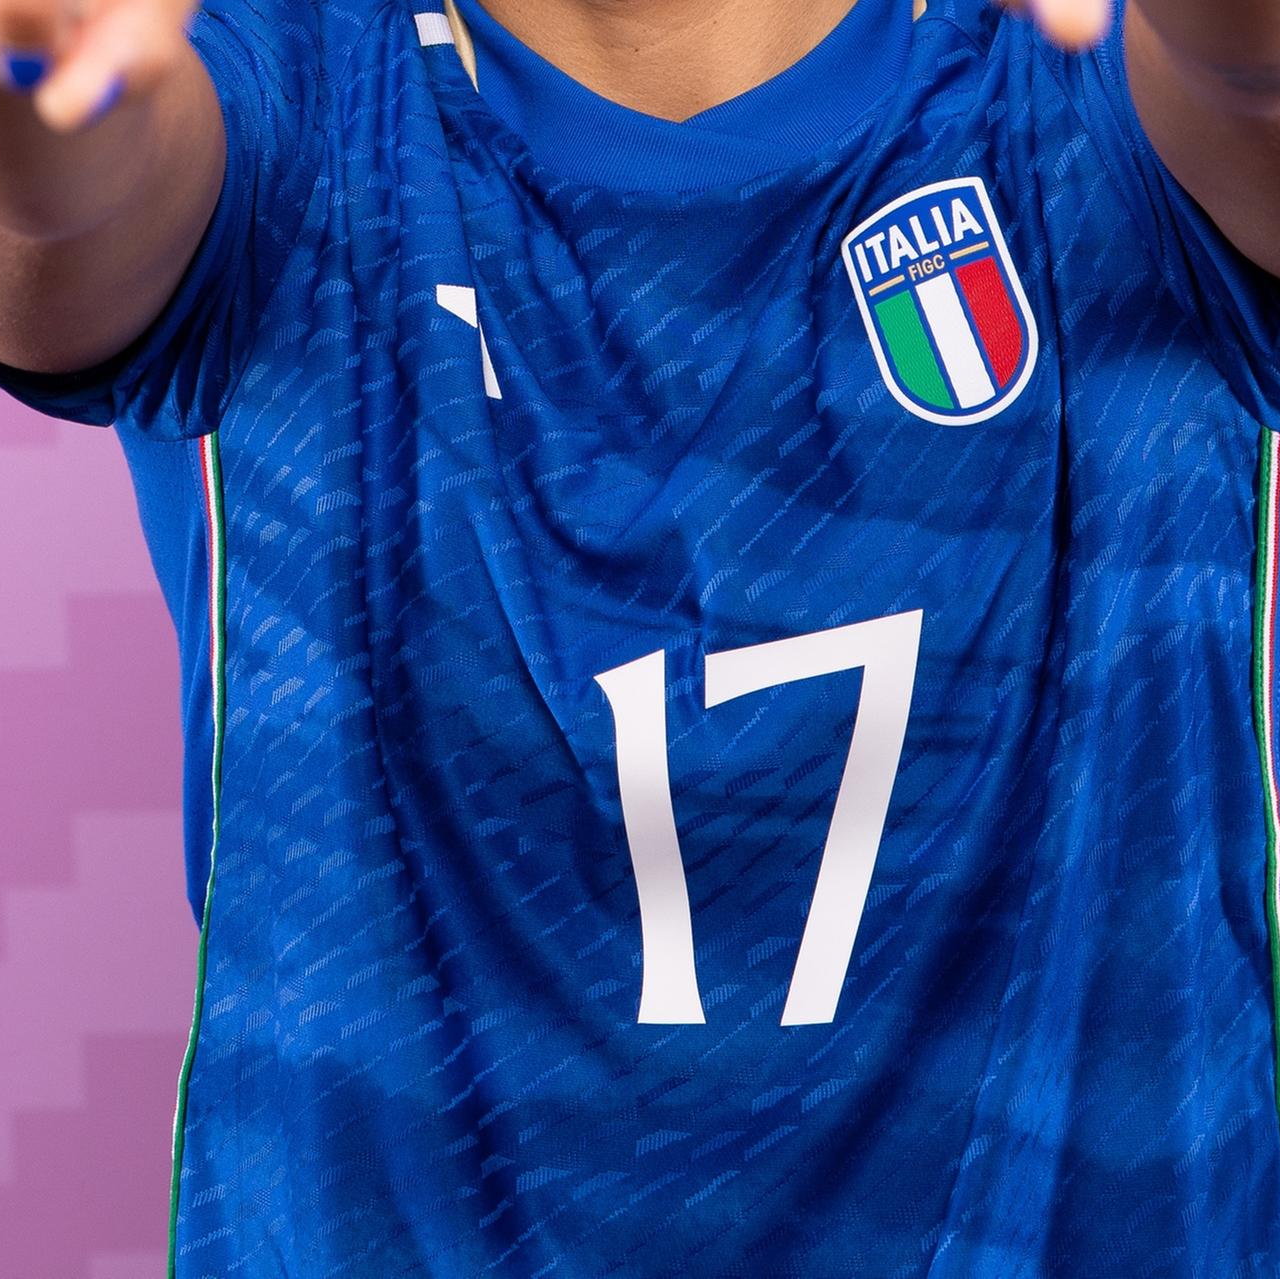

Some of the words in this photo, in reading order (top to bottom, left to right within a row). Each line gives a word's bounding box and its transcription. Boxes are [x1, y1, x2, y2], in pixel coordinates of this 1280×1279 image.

[855, 198, 983, 283] ITALIA
[908, 254, 945, 281] FIGC
[594, 609, 923, 1026] 17
